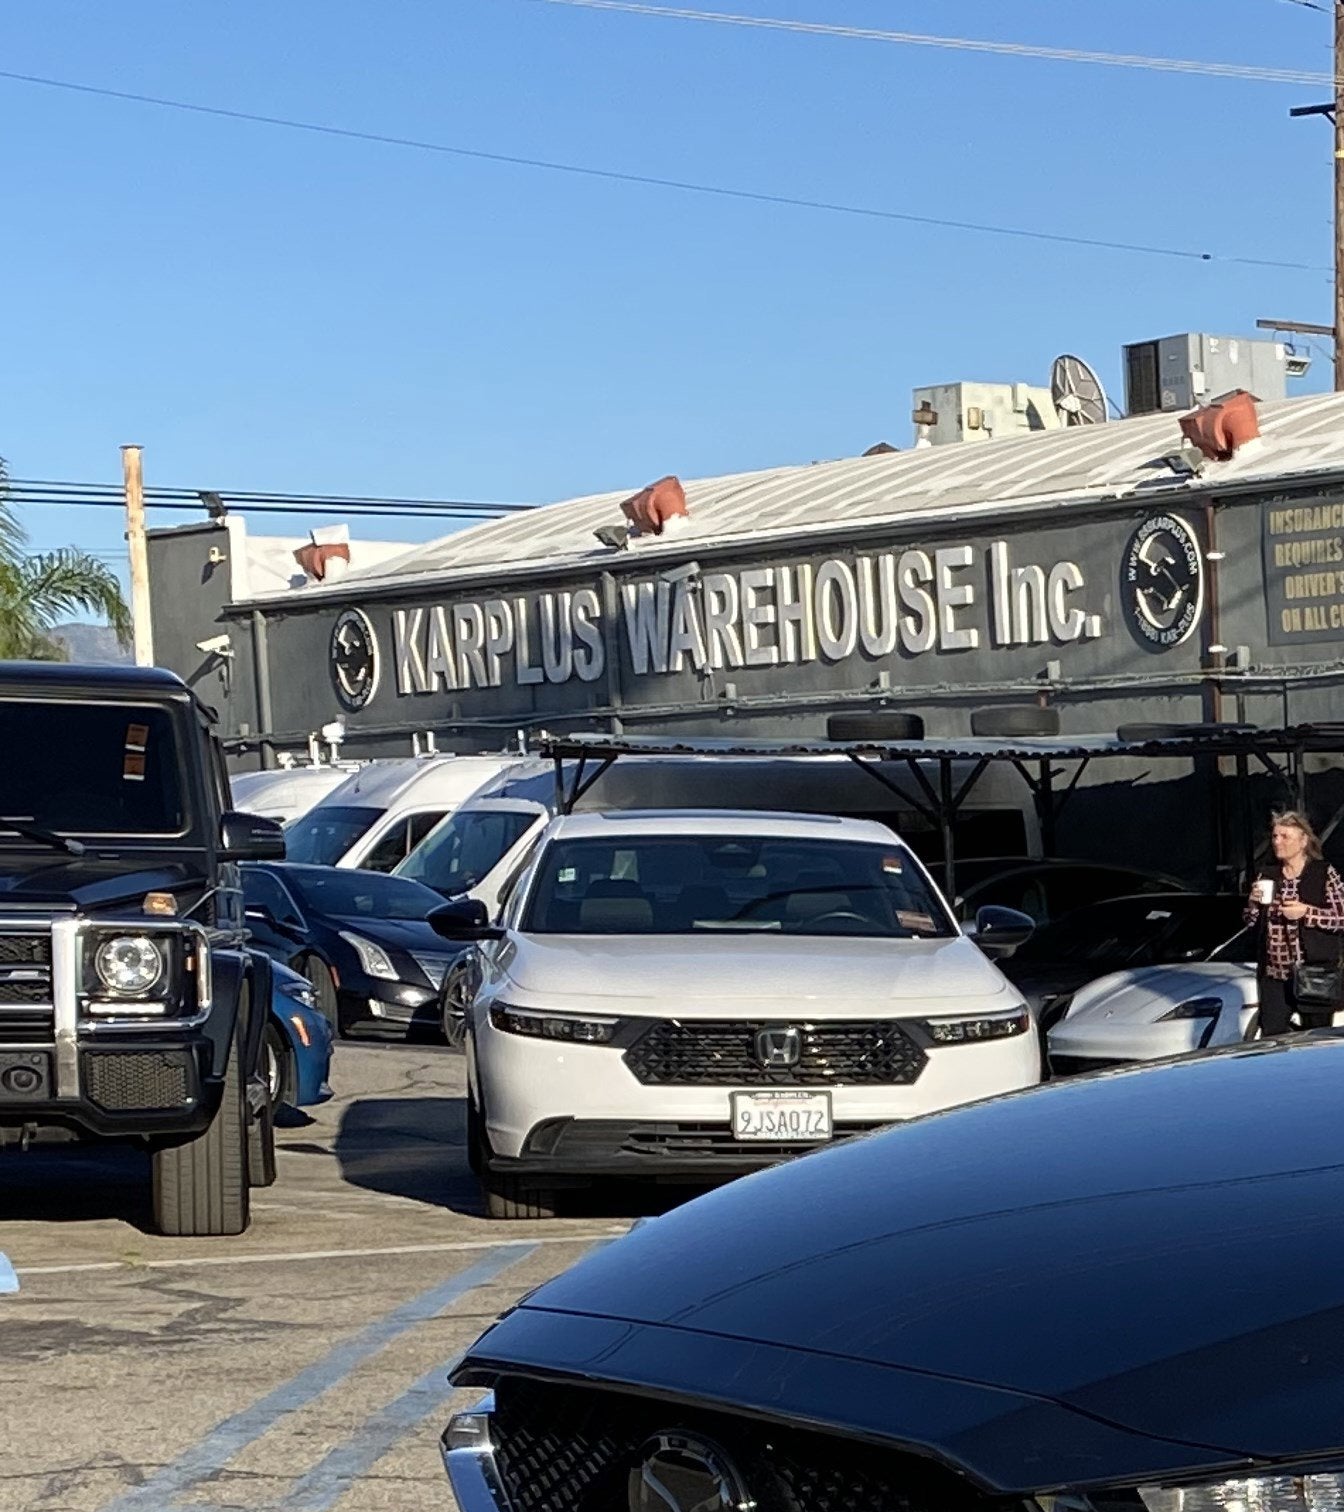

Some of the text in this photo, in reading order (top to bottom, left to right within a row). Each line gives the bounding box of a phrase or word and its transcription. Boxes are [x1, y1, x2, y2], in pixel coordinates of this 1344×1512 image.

[1275, 537, 1342, 567] REQUIRES
[393, 589, 605, 694] KARPLUS
[621, 545, 979, 675] WAREHOUSE
[991, 541, 1102, 645] Inc.
[1281, 608, 1302, 632] ON
[1304, 606, 1328, 631] ALL
